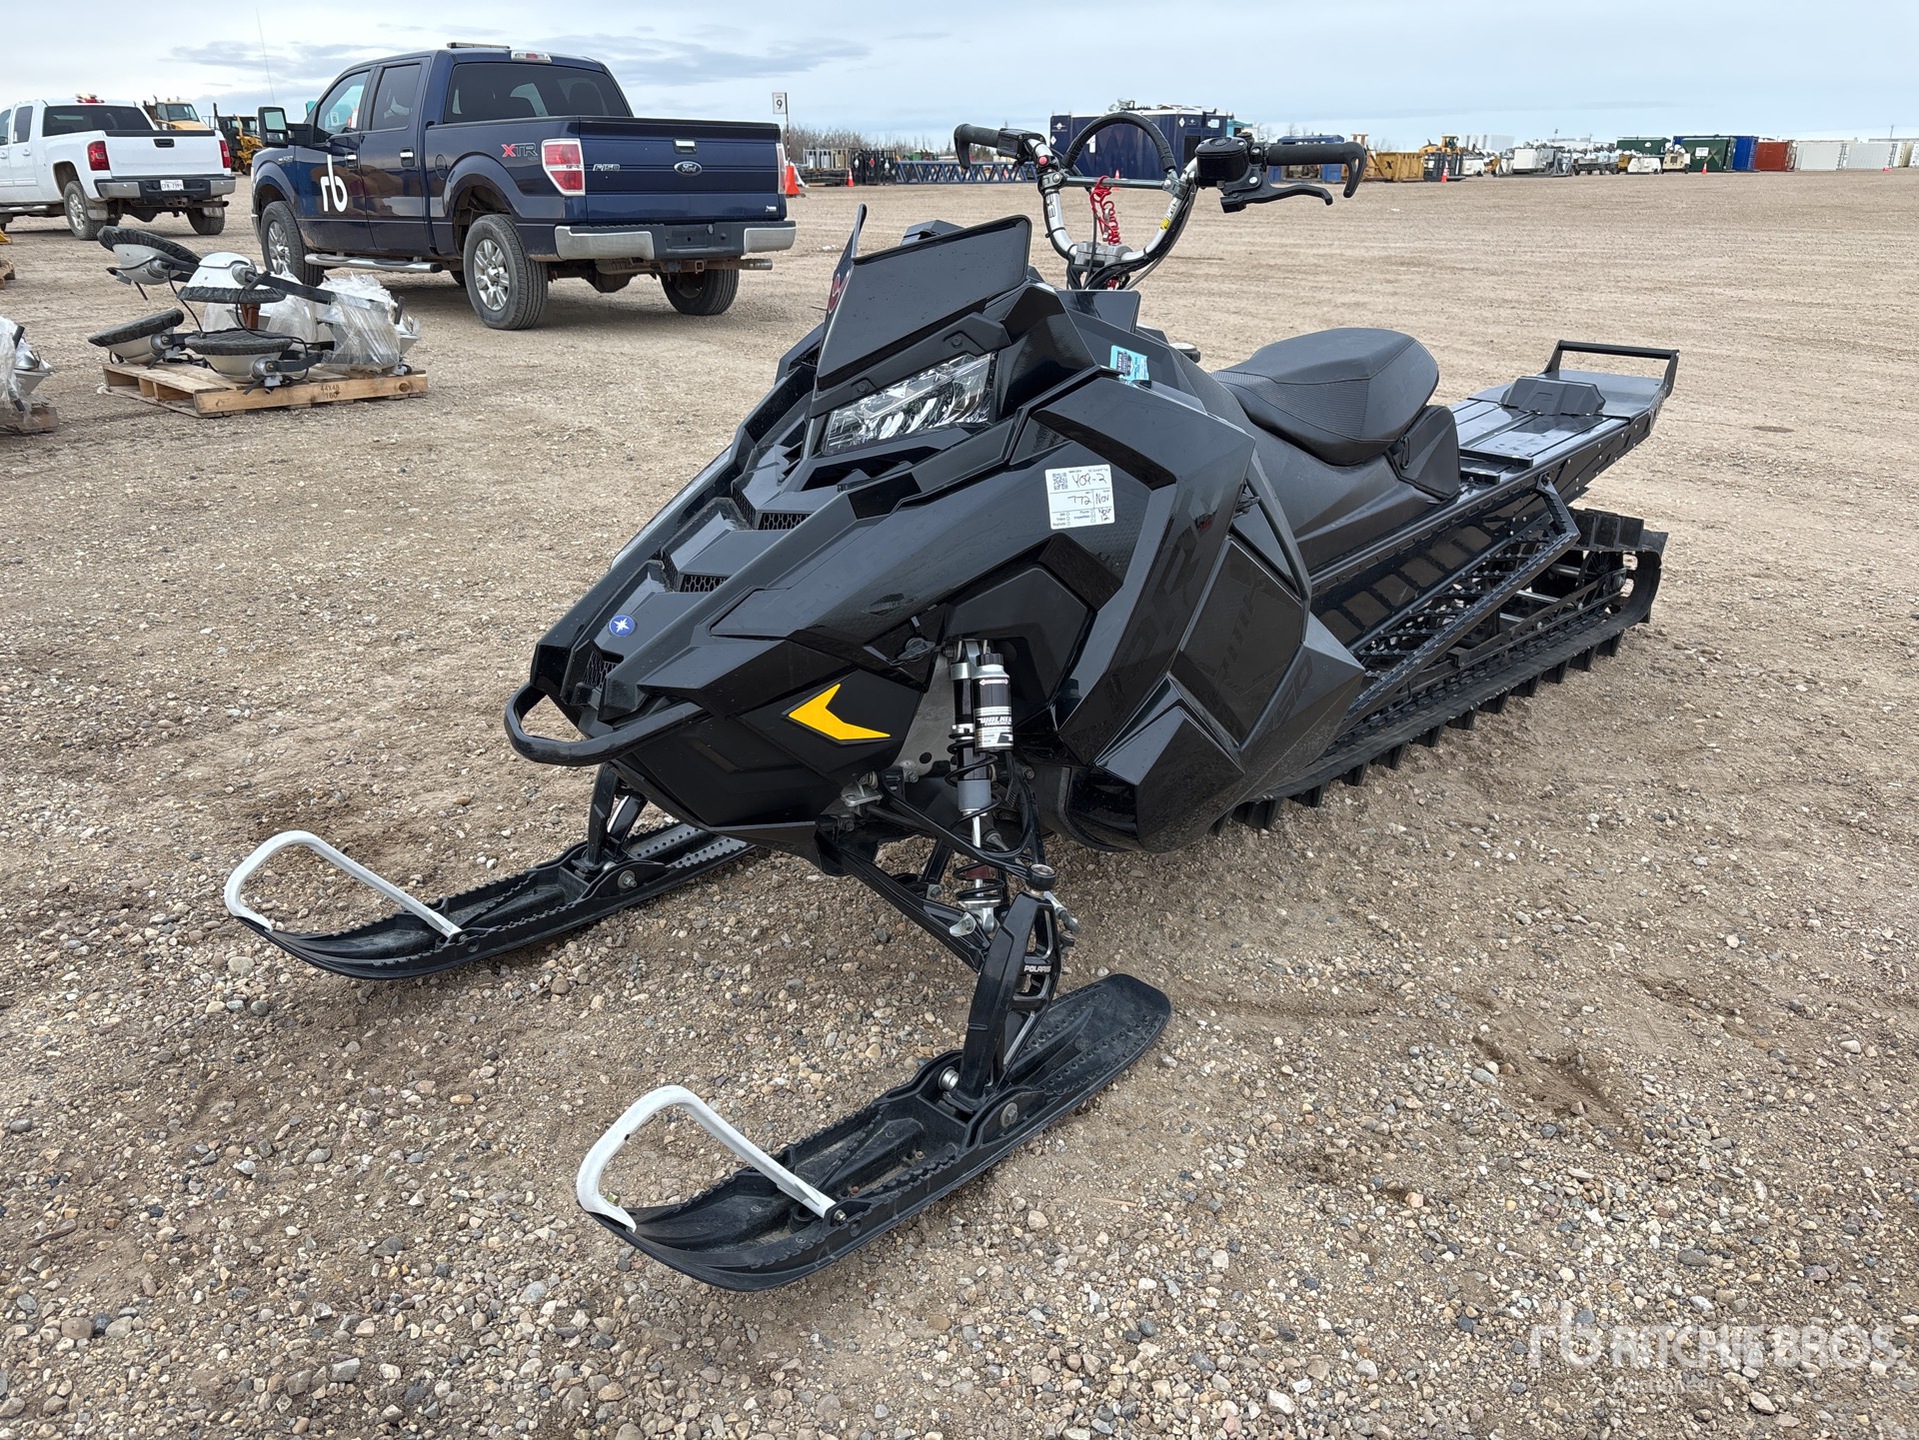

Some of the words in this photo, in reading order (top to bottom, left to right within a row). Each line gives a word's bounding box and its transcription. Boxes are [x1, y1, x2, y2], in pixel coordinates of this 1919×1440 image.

[776, 99, 783, 110] 9
[501, 143, 539, 158] XTR
[681, 162, 697, 173] Ford
[1023, 964, 1052, 973] POLARIS
